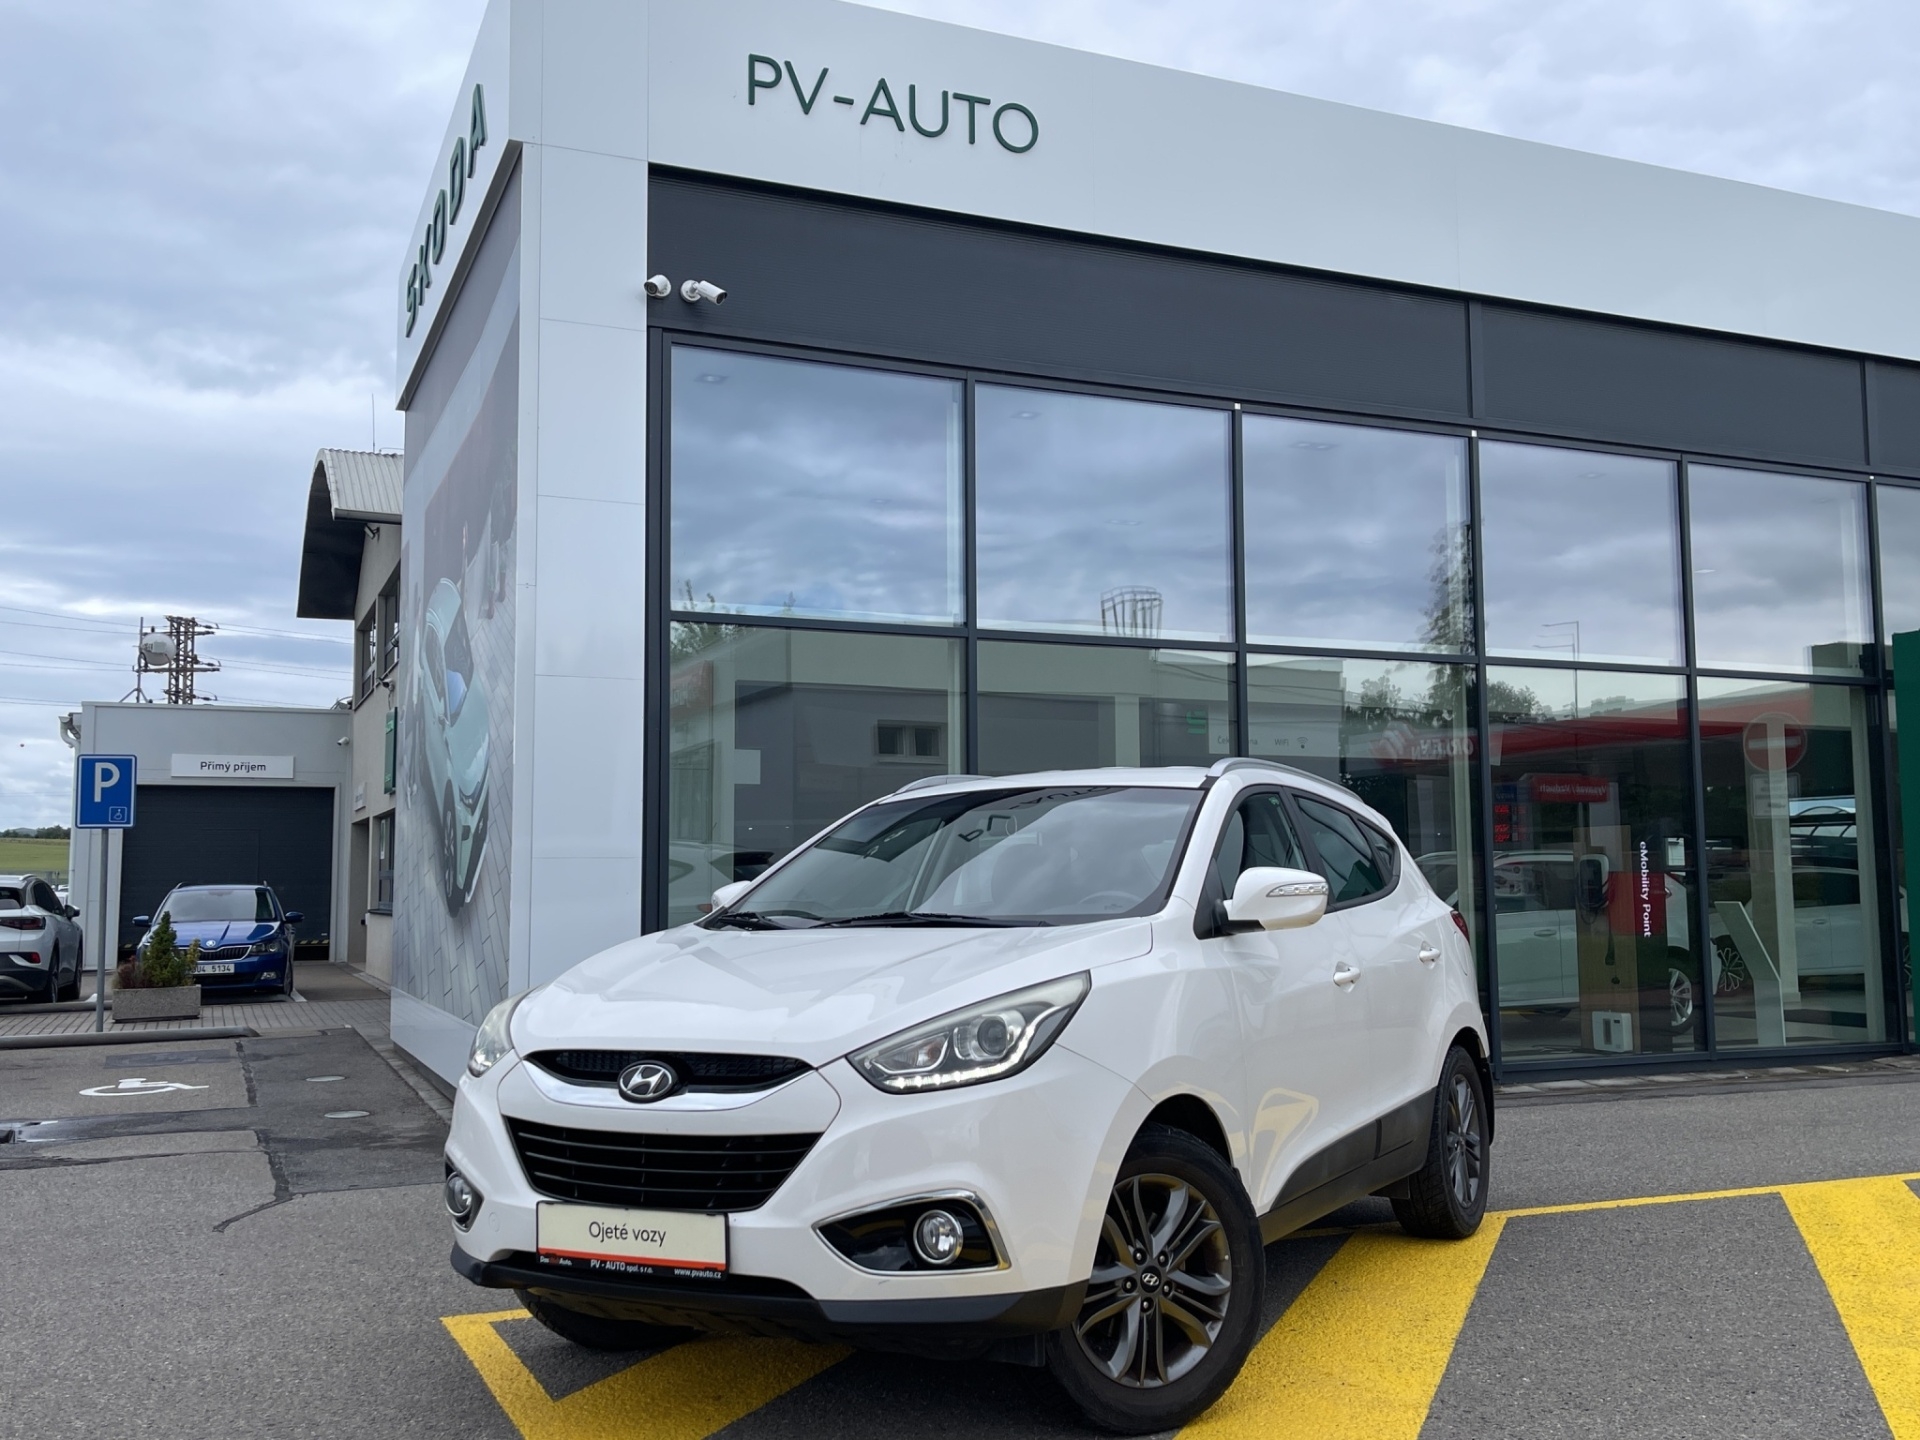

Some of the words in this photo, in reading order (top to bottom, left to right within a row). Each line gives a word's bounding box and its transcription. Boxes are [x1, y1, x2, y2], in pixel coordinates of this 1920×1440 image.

[747, 53, 1040, 154] PV-AUTO
[200, 761, 231, 773] Přímý
[233, 761, 266, 773] příjem
[94, 762, 120, 803] P
[1640, 841, 1650, 901] eMobility
[1642, 903, 1652, 938] Point
[211, 964, 231, 973] 5134
[588, 1221, 629, 1243] Ojeté
[631, 1228, 667, 1248] vozy
[590, 1259, 600, 1269] PV
[605, 1261, 626, 1271] AUTO
[626, 1265, 639, 1273] spol.
[674, 1268, 722, 1279] www.pvauto.cz
